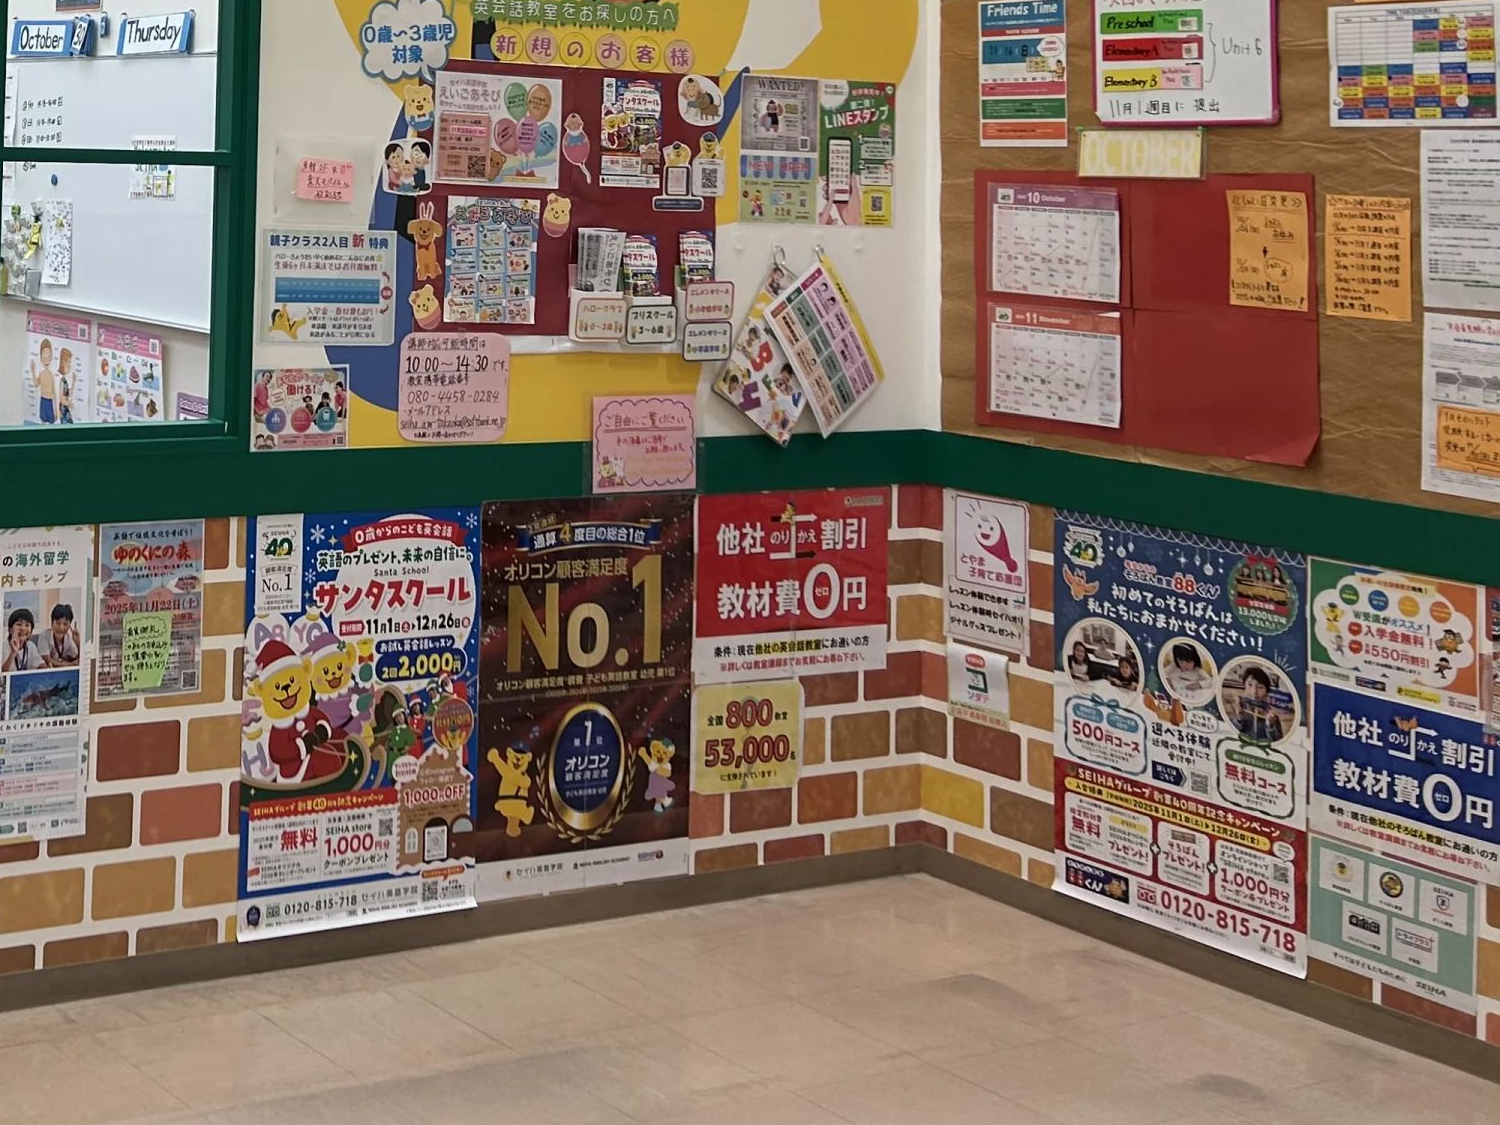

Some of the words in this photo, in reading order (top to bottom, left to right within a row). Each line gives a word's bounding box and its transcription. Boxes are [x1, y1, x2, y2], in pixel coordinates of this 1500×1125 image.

[987, 3, 1030, 16] Friends
[1032, 2, 1058, 14] Time
[20, 25, 63, 50] October
[74, 23, 86, 47] 30
[128, 17, 180, 48] Thursday
[391, 45, 425, 65] 対象
[495, 33, 691, 67] 新規のお客様
[1222, 37, 1250, 55] Unit
[440, 87, 501, 103] えいごあそび
[758, 79, 804, 91] WANTED!
[824, 105, 889, 129] LINEスタンプ
[1028, 191, 1040, 204] 10
[270, 234, 348, 249] 親子クラス2人目
[352, 233, 364, 249] 新
[368, 237, 389, 250] 特典
[584, 305, 622, 314] ハロークラス
[632, 310, 674, 321] プリスクール
[1026, 312, 1038, 324] 11
[407, 389, 500, 404] 080-4458-0284
[355, 525, 453, 543] 0歳からのこども英会話
[534, 523, 646, 549] 通算4度目の総合1位
[114, 541, 192, 565] ゆのくにの森
[317, 547, 472, 569] 英語のプレゼント、未来の自信に。
[960, 553, 986, 567] とやま
[374, 568, 397, 577] Santa
[402, 566, 430, 575] School
[504, 557, 628, 582] オリコン顧客満足度
[968, 566, 1024, 587] 子育て応援団
[262, 573, 292, 593] No.1
[718, 563, 867, 620] 教材費0円
[816, 586, 830, 597] ゼロ
[104, 596, 200, 615] 2025年11月22日(土)
[316, 577, 471, 613] サンタスクール
[950, 586, 1008, 606] レッスン体験できます
[1111, 582, 1233, 625] 初めてのそろばんは
[506, 555, 662, 673] No.1
[950, 601, 1024, 625] レッスン体験時セイハオリ
[1353, 610, 1431, 636] W受講がオススメ!
[1087, 597, 1264, 651] 私たちにおまかせください!
[380, 637, 453, 653] お試し英会話レッスン
[1364, 627, 1434, 650] 入学金無料!
[1371, 644, 1430, 669] 550円割引
[1072, 719, 1141, 753] 500円コース
[1152, 722, 1212, 751] 選べる体験
[705, 735, 796, 768] 53,000名
[1152, 738, 1211, 761] 近隣の教室にて
[1168, 752, 1196, 766] 受付中!
[565, 753, 610, 772] オリコン
[565, 767, 608, 782] 顧客満足度
[1225, 762, 1287, 795] 無料コース
[1078, 768, 1152, 798] SEIHAグループ
[1154, 789, 1281, 837] 創業40周年記念キャンペーン
[1332, 758, 1494, 829] 教材費0円
[1434, 791, 1450, 803] ゼロ
[326, 825, 350, 835] SEIHA
[352, 823, 372, 833] store
[1072, 816, 1102, 839] 無料
[280, 827, 318, 851] 無料
[324, 833, 390, 858] 1,000円分
[1168, 840, 1199, 858] そろばん
[324, 853, 389, 869] クーポンプレゼント
[1108, 840, 1150, 863] プレゼント!
[1162, 849, 1206, 874] プレゼント!
[362, 885, 418, 901] セイハ英語学院
[1220, 867, 1290, 903] 1,000円分
[1433, 886, 1454, 898] SEIHA
[284, 895, 358, 915] 0120-815-718
[1161, 890, 1296, 953] 0120-815-718
[1416, 981, 1447, 997] SEIHA
